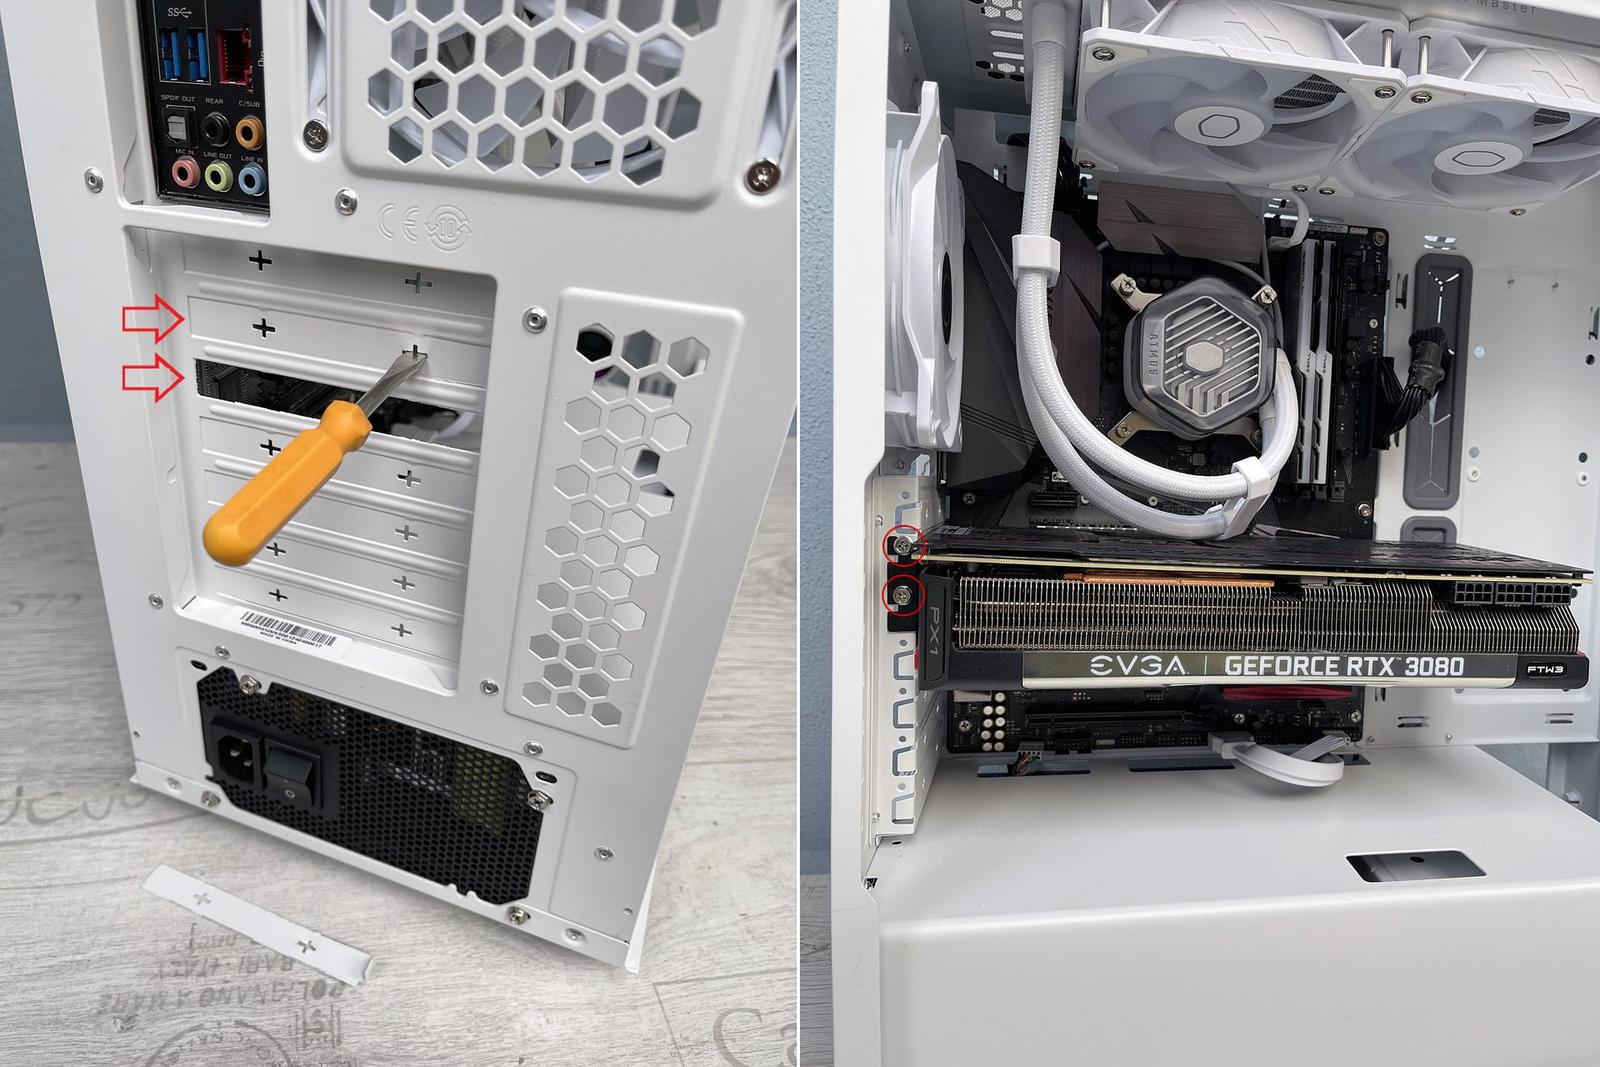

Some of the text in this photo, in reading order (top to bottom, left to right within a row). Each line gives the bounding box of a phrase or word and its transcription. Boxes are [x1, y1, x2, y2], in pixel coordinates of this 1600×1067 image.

[205, 97, 224, 105] REAR
[238, 100, 261, 108] C/SUB
[203, 151, 233, 160] LINE OUT
[1148, 333, 1159, 377] ATMOS
[929, 606, 940, 656] PX1
[1090, 655, 1186, 676] EVGA
[1224, 655, 1465, 676] GEFORCE RTX 3080
[1526, 665, 1564, 674] FTW3
